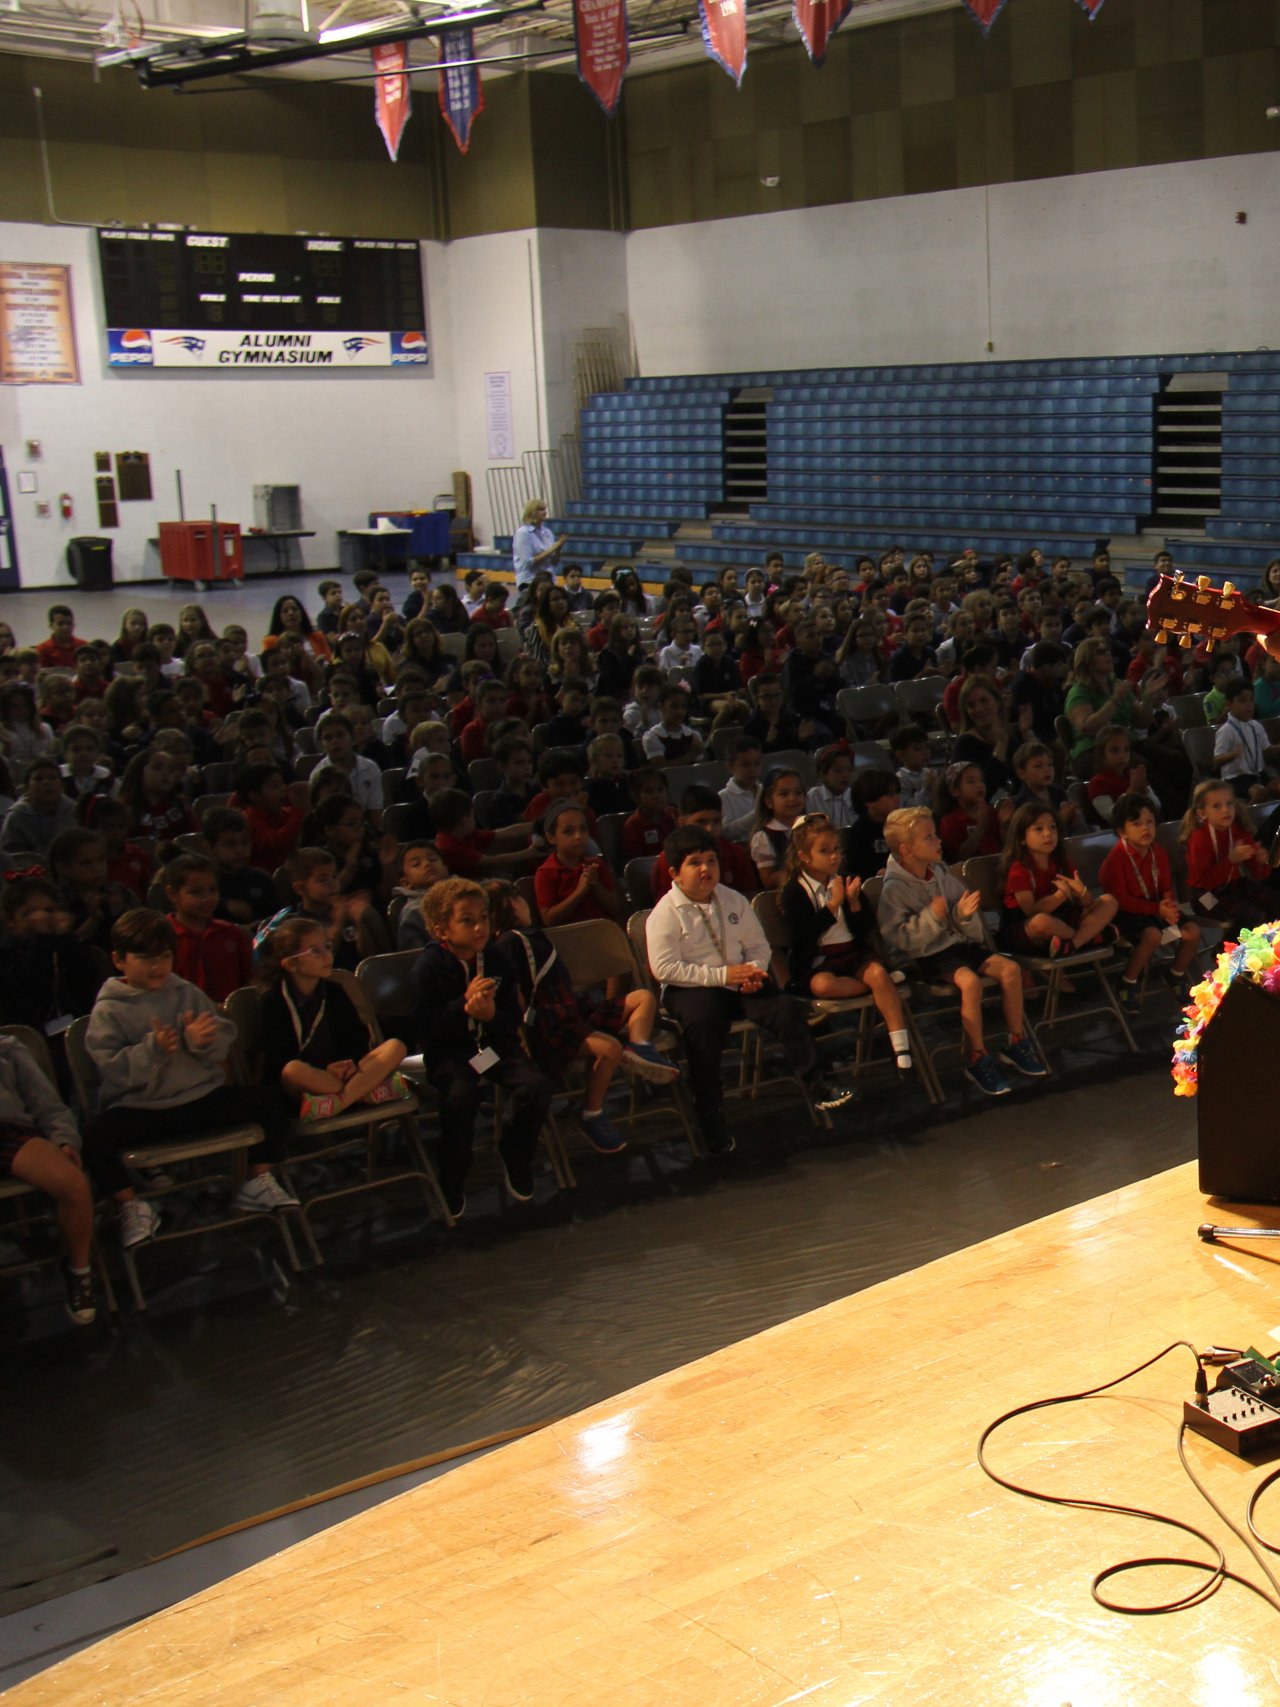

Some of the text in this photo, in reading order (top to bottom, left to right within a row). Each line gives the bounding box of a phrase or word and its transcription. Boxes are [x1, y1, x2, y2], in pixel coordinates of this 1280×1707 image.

[186, 235, 229, 247] GUEST
[307, 240, 343, 251] HOME
[238, 273, 275, 282] PERIOD
[199, 293, 226, 302] FOULS
[262, 295, 281, 303] OUTS
[240, 335, 311, 347] ALUMNI
[110, 353, 152, 362] PEPSI
[218, 350, 333, 363] GYMNASIUM
[392, 353, 426, 362] PEPSI
